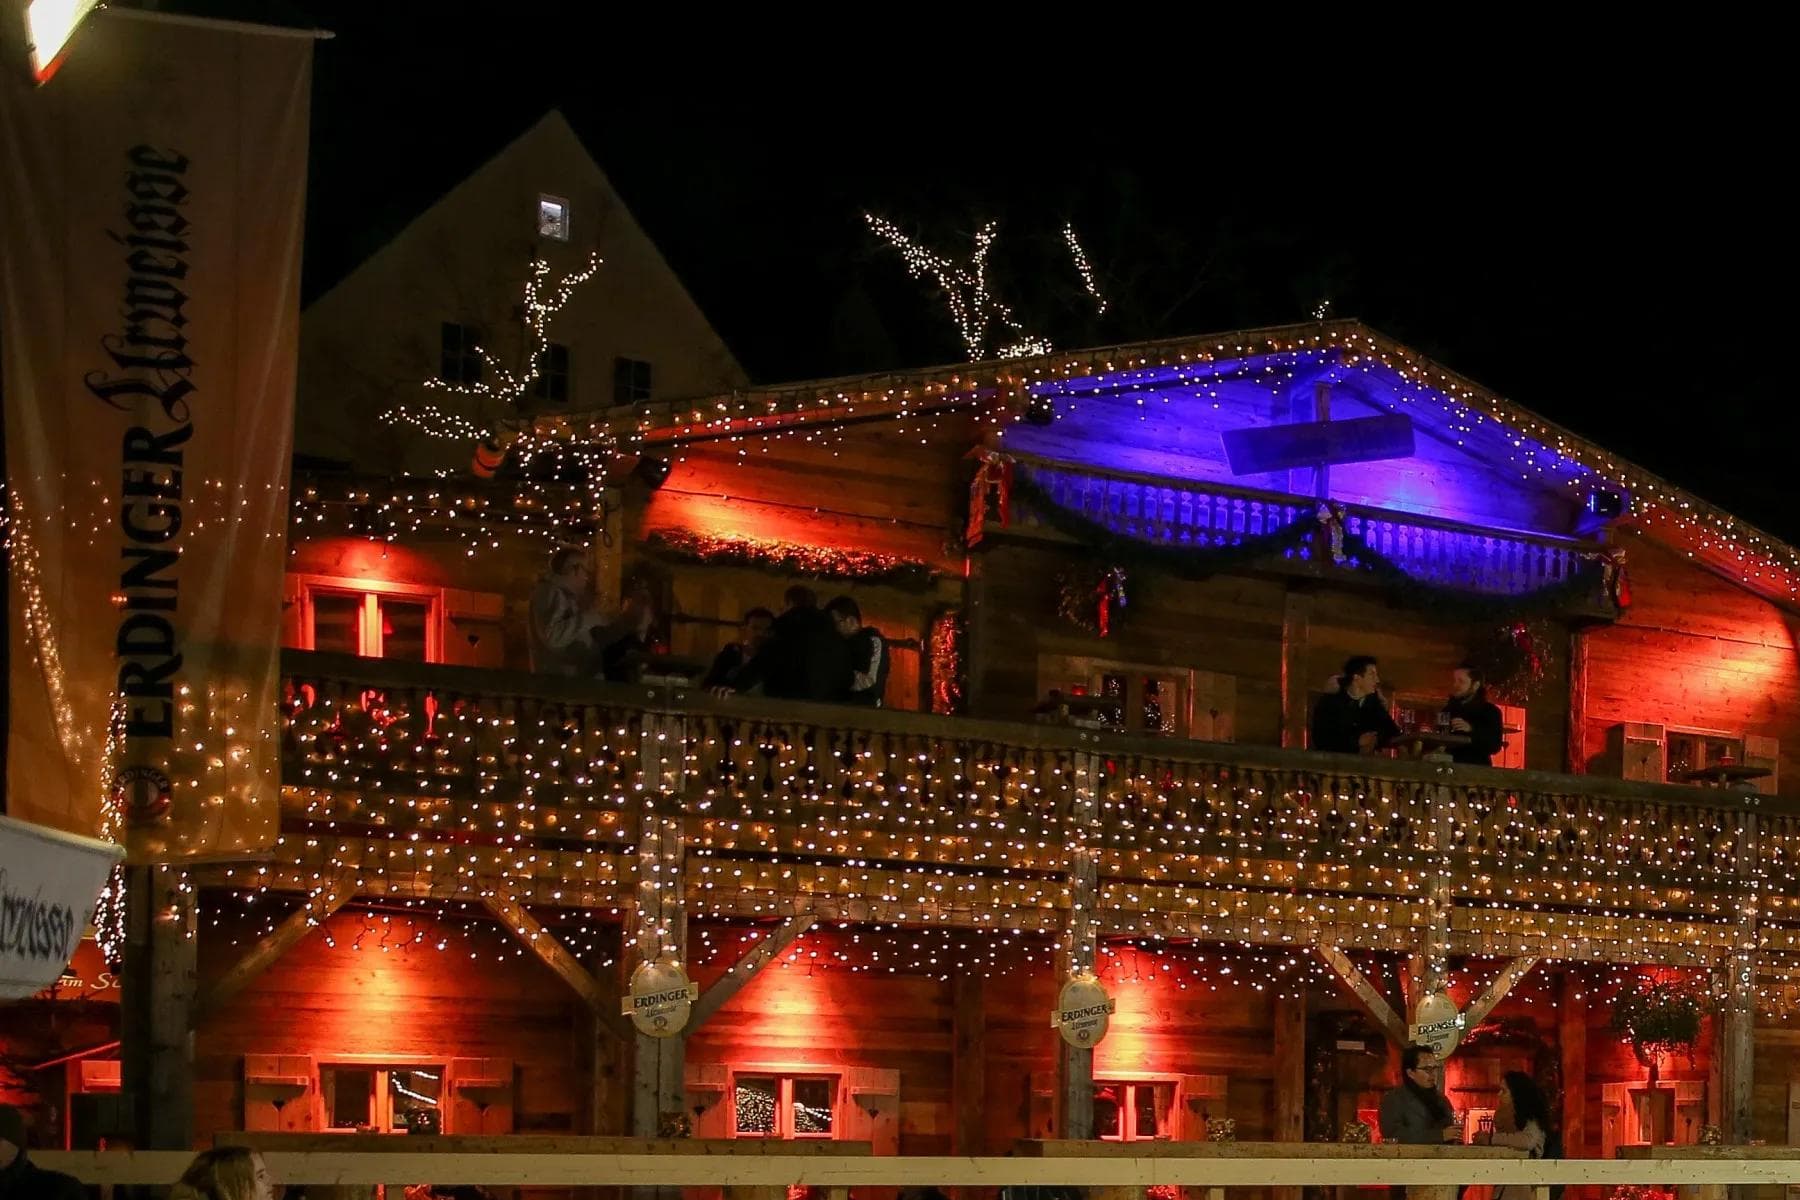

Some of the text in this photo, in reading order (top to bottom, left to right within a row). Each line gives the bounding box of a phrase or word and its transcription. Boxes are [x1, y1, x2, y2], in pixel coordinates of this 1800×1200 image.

[84, 145, 199, 740] ERDINGER Urweisse
[634, 989, 688, 1008] ERDINGER
[1062, 1004, 1107, 1022] ERDINGER
